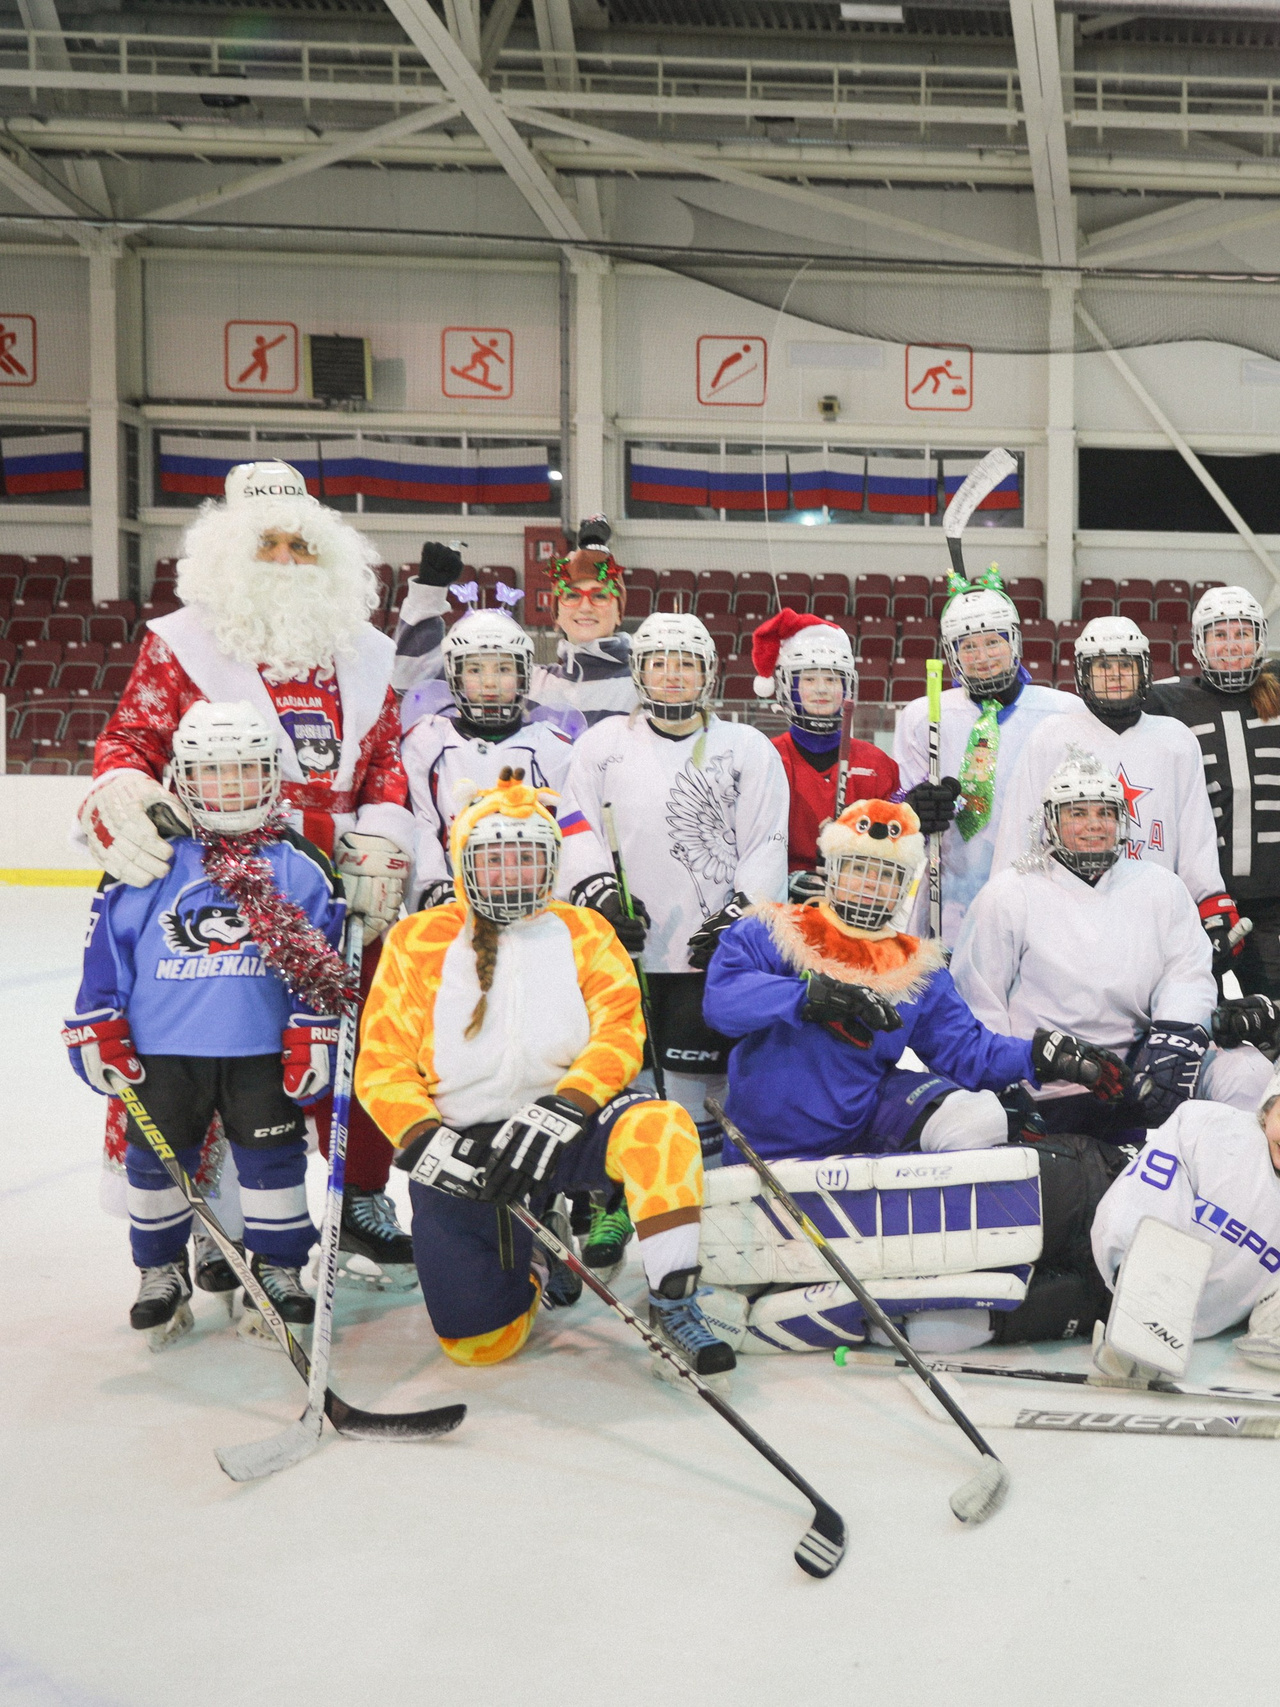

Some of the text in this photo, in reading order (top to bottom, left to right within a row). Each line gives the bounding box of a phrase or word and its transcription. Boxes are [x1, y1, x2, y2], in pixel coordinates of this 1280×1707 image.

[155, 956, 267, 980] МЕДВЕЖАТА
[666, 1047, 720, 1061] CCM
[253, 1121, 297, 1139] CCM
